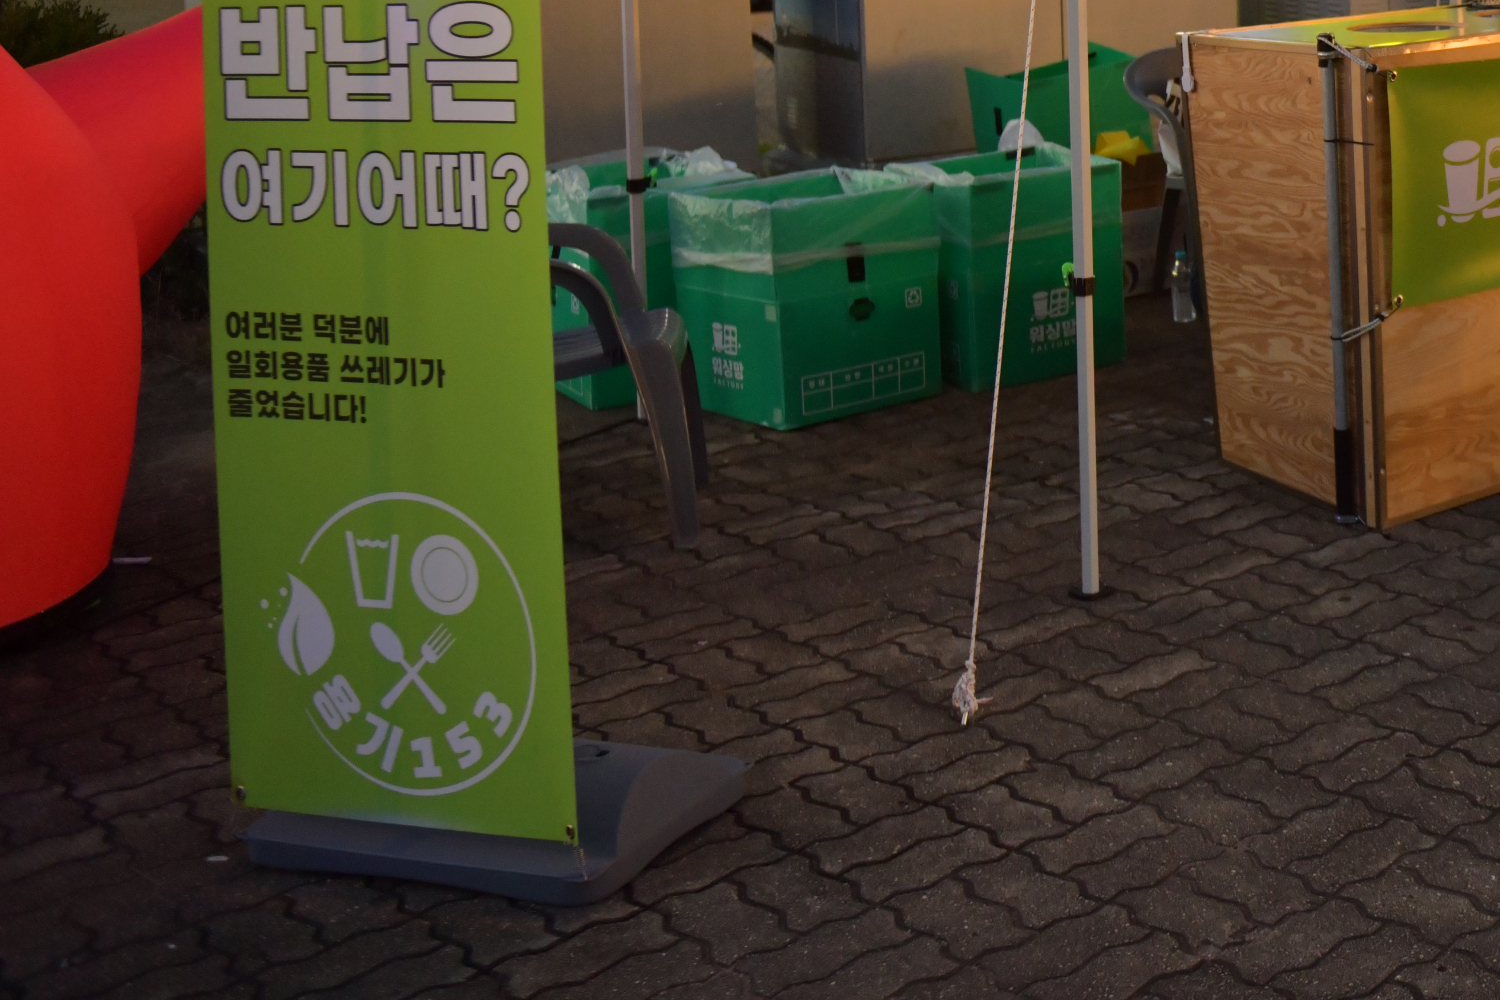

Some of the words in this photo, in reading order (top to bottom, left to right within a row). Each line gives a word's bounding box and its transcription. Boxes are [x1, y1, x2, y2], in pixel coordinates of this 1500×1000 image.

[218, 1, 519, 123] 반납은
[221, 148, 530, 232] 여기어때?
[225, 311, 303, 342] 여러분
[314, 314, 390, 346] 덕분에
[226, 350, 330, 382] 일회용품
[340, 356, 446, 389] 쓰레기가
[227, 388, 368, 424] 줄었습니다!
[312, 673, 513, 778] 용기153
